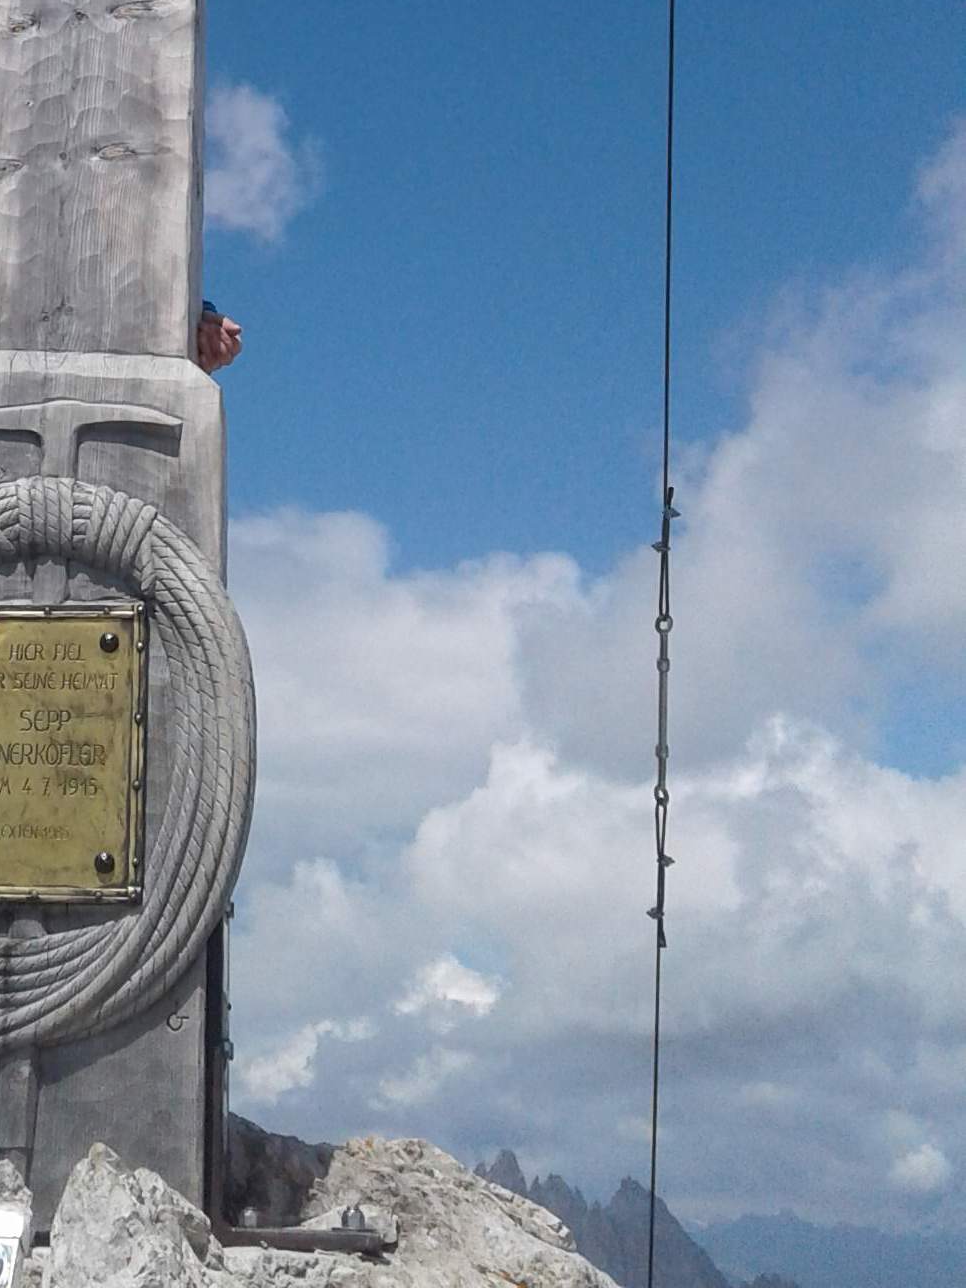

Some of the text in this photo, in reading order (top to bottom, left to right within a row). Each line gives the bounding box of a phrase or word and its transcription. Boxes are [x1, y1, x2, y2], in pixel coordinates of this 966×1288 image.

[8, 643, 86, 661] HIER FIEL
[12, 671, 56, 690] SEINE
[60, 671, 119, 690] HEIMAT
[19, 709, 72, 732] SEPP
[57, 776, 100, 796] 1915
